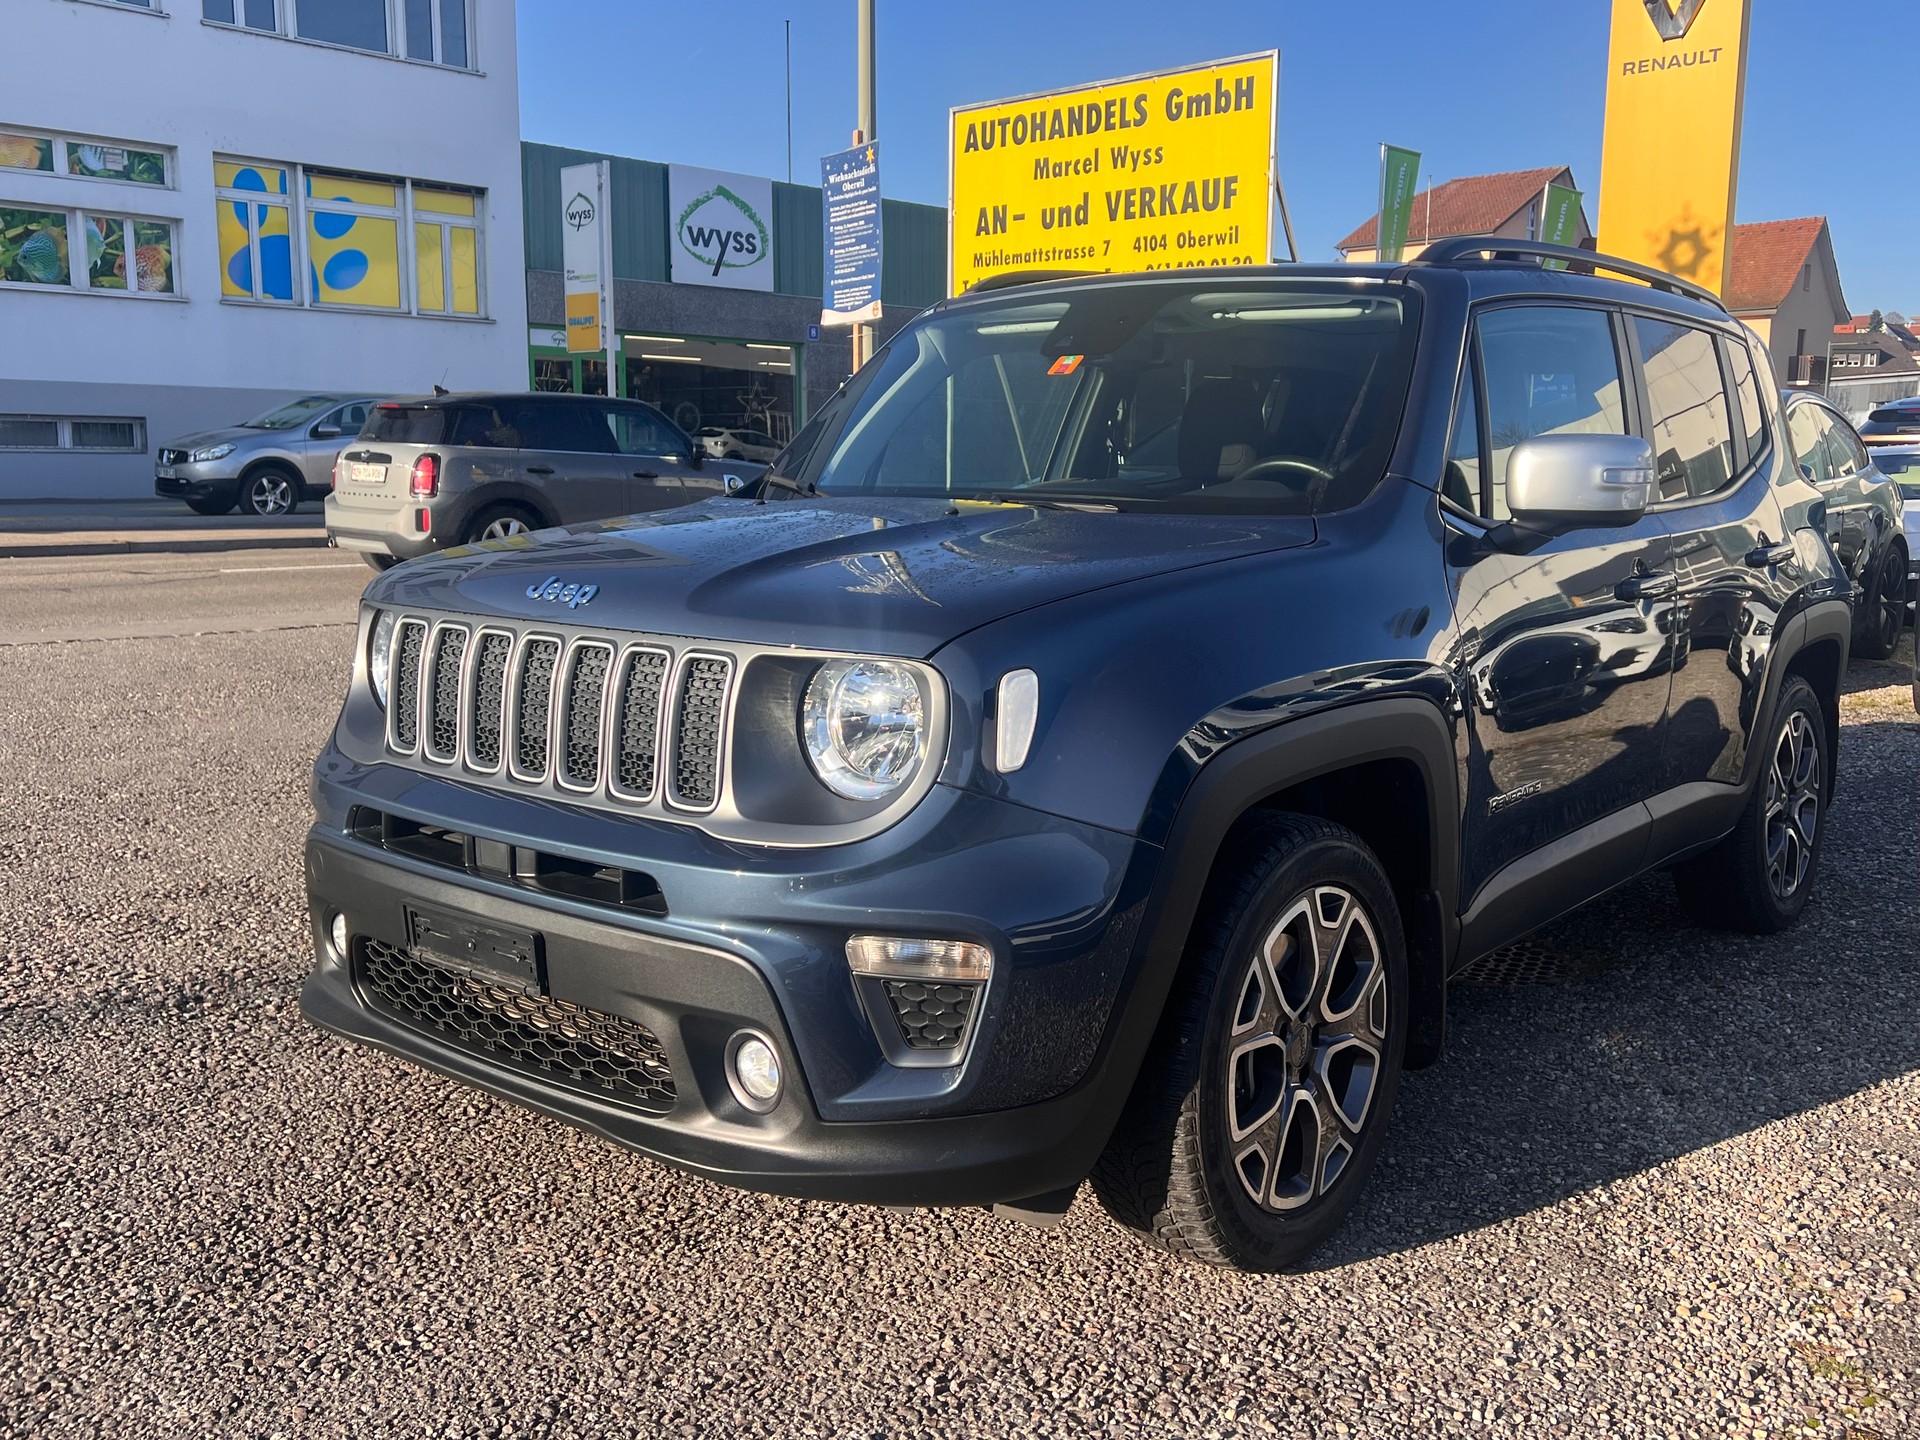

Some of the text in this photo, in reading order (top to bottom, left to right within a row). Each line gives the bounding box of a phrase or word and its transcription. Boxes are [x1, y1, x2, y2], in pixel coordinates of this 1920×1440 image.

[1622, 47, 1723, 76] RENAULT
[964, 75, 1255, 154] AUTOHANDELS GmbH
[1033, 145, 1164, 181] Marcel Wyss
[842, 177, 865, 192] Oberwil
[1041, 192, 1090, 230] und
[1105, 175, 1239, 222] VERKAUF
[686, 225, 757, 277] wyss
[973, 225, 1240, 269] Mühlemattstrasse 7 4104 Oberwil
[811, 327, 817, 338] 8
[525, 575, 599, 610] Jeep
